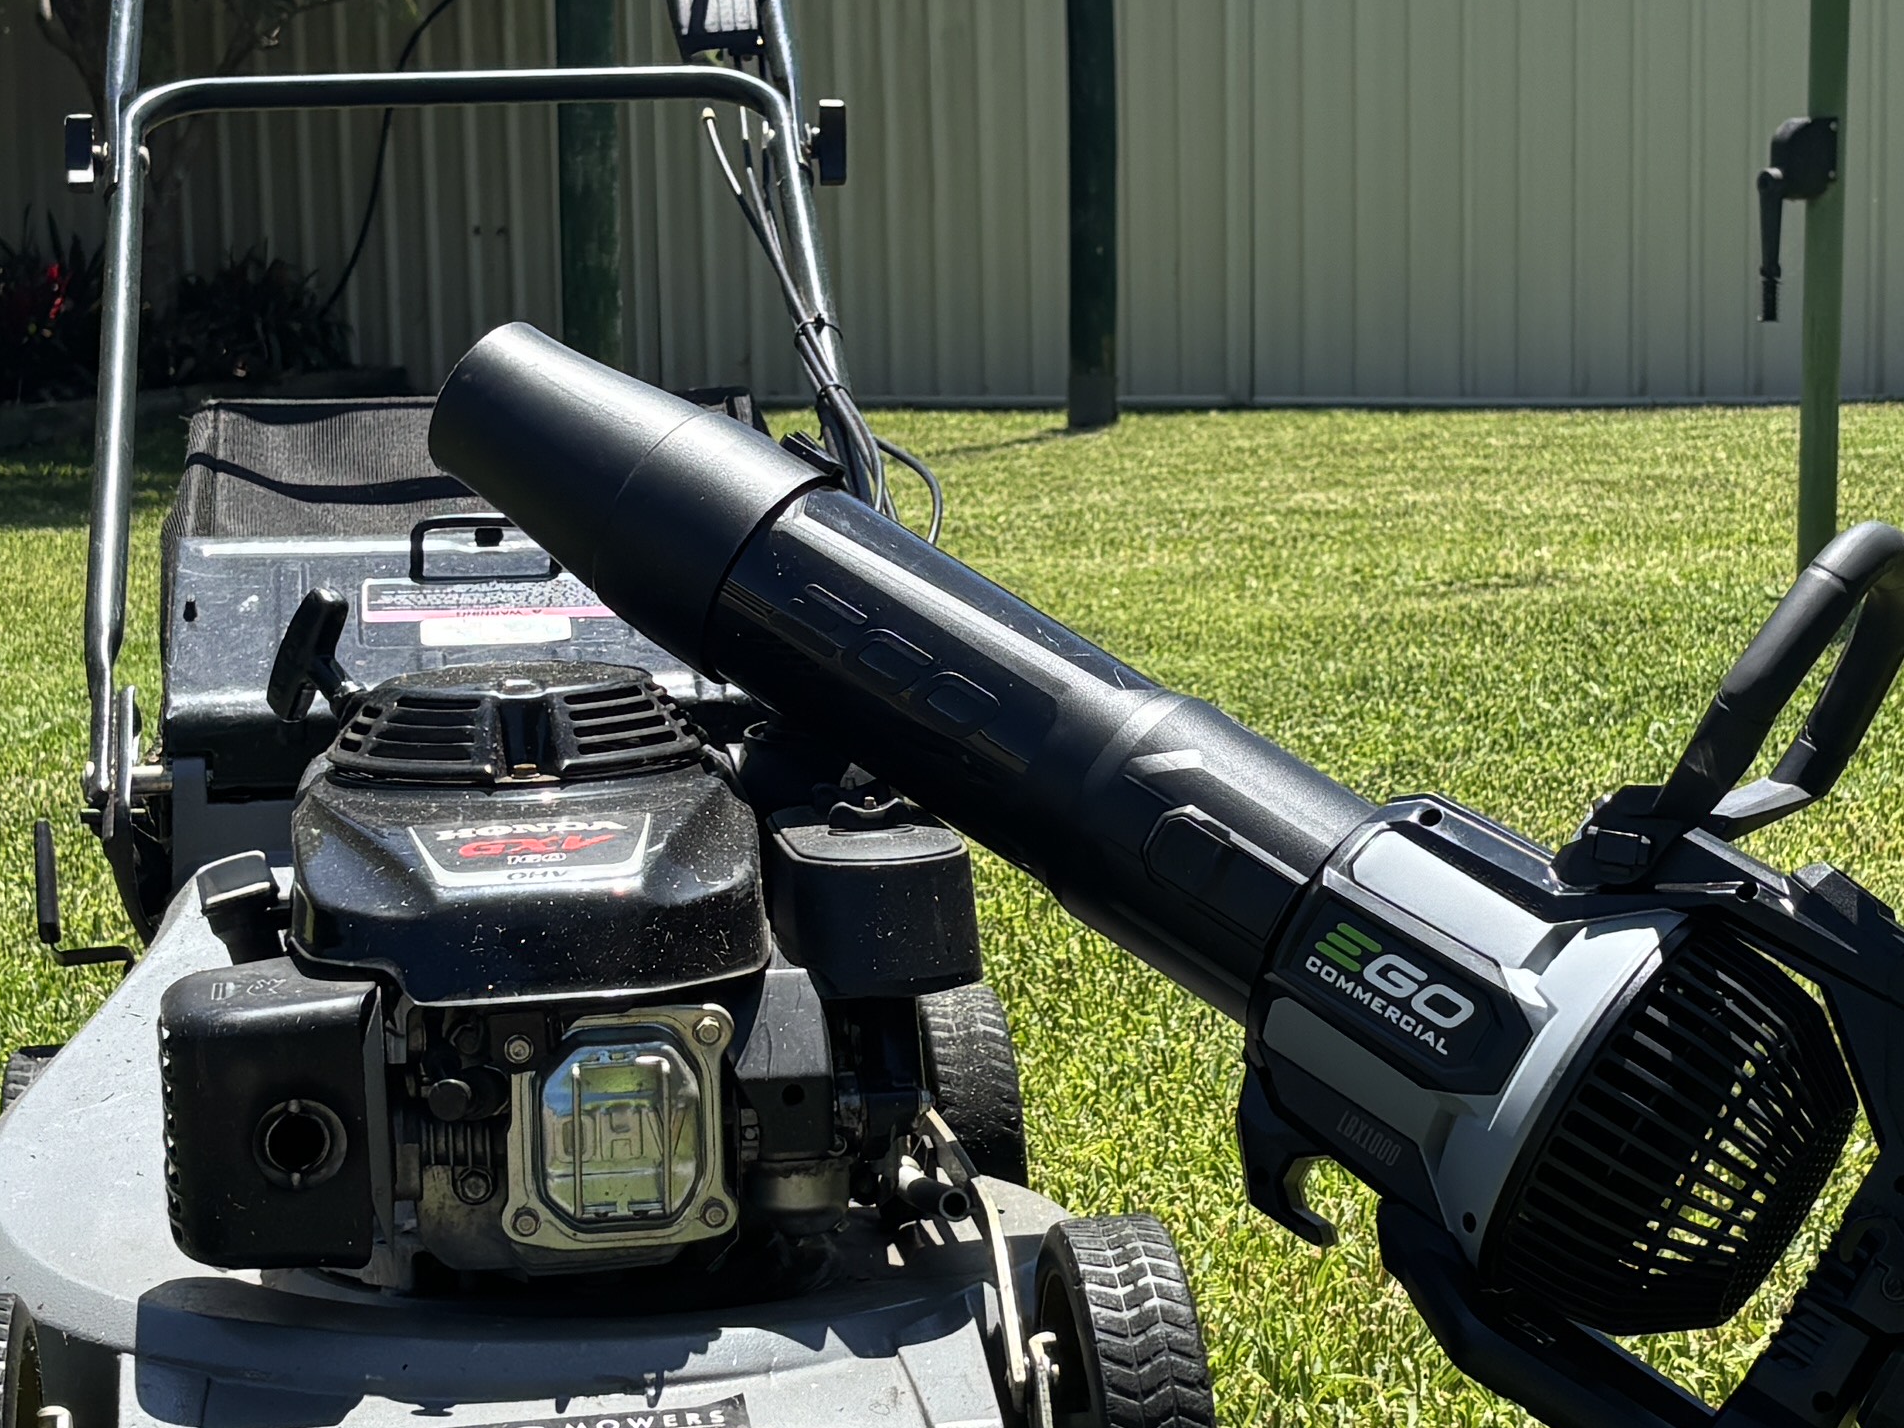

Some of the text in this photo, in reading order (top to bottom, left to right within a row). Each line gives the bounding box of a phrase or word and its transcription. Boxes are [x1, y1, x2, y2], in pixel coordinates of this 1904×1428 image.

[435, 821, 628, 842] HONDA
[458, 833, 617, 859] GXV
[507, 871, 568, 881] OHV
[1314, 922, 1475, 1029] EGO
[1305, 955, 1449, 1056] COMMERCIAL
[553, 1107, 687, 1164] OHV
[1335, 1109, 1403, 1167] LBX1000
